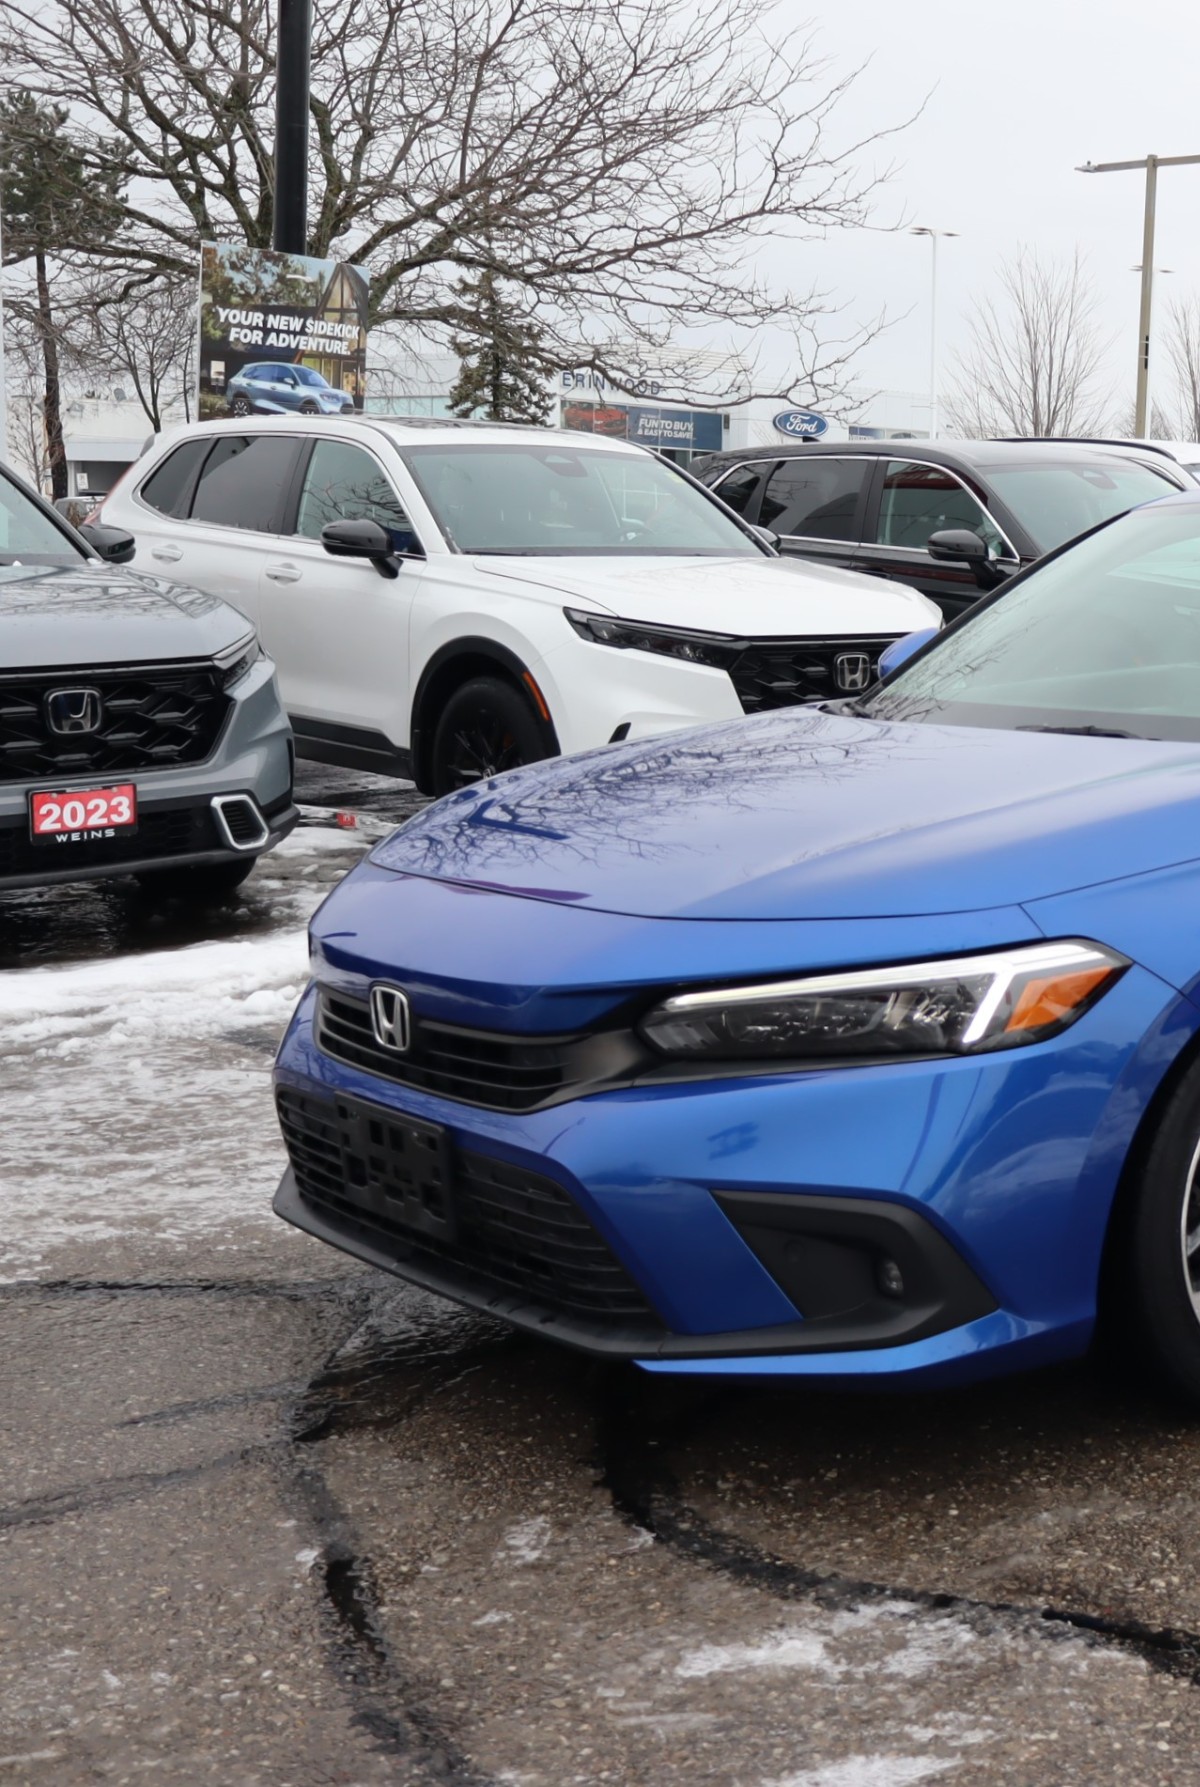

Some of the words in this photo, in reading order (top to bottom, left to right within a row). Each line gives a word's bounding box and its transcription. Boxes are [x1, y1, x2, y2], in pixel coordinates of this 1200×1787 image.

[217, 307, 264, 327] YOUR
[267, 314, 303, 332] NEW
[305, 319, 360, 340] SIDEKICK
[229, 327, 263, 345] FOR
[266, 334, 350, 355] ADVENTURE.
[639, 418, 659, 429] FUN
[660, 420, 673, 430] TO
[786, 413, 818, 433] Ford
[663, 430, 673, 438] TO
[39, 796, 131, 831] 2023
[56, 828, 115, 843] WEINS
